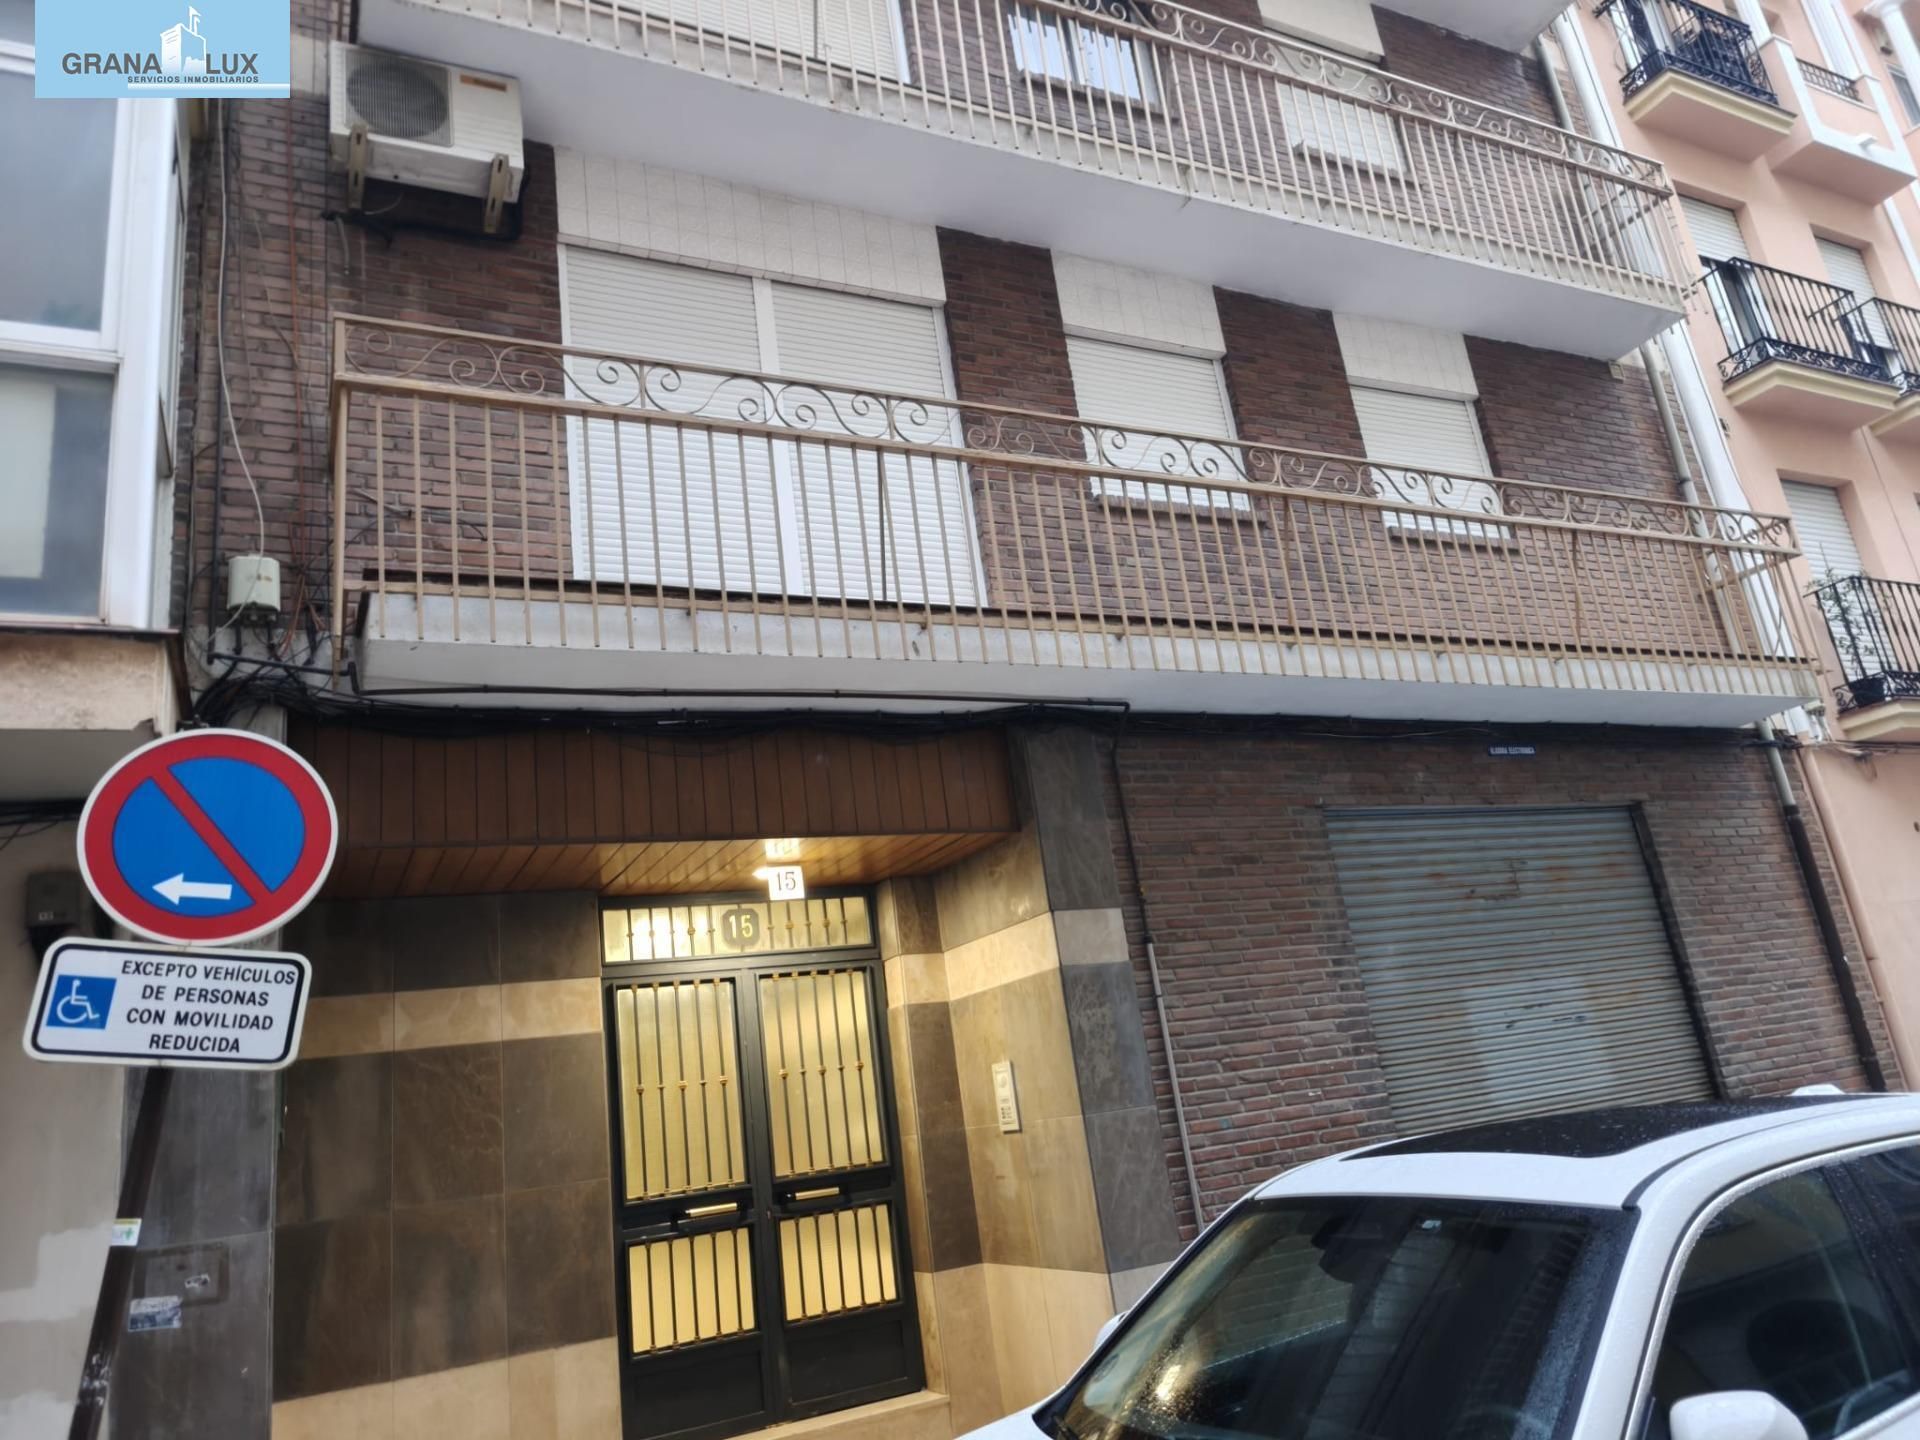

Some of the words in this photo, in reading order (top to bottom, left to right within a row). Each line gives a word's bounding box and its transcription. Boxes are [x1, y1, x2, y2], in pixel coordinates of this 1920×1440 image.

[776, 871, 796, 892] 15
[729, 914, 753, 939] 15
[121, 960, 197, 979] EXCEPTO
[203, 964, 295, 985] VEHÍCULOS
[141, 985, 165, 1001] DE
[174, 987, 269, 1007] PERSONAS
[126, 1008, 165, 1025] CON
[174, 1011, 273, 1030] MOVILIDAD
[149, 1034, 240, 1053] REDUCIDA
